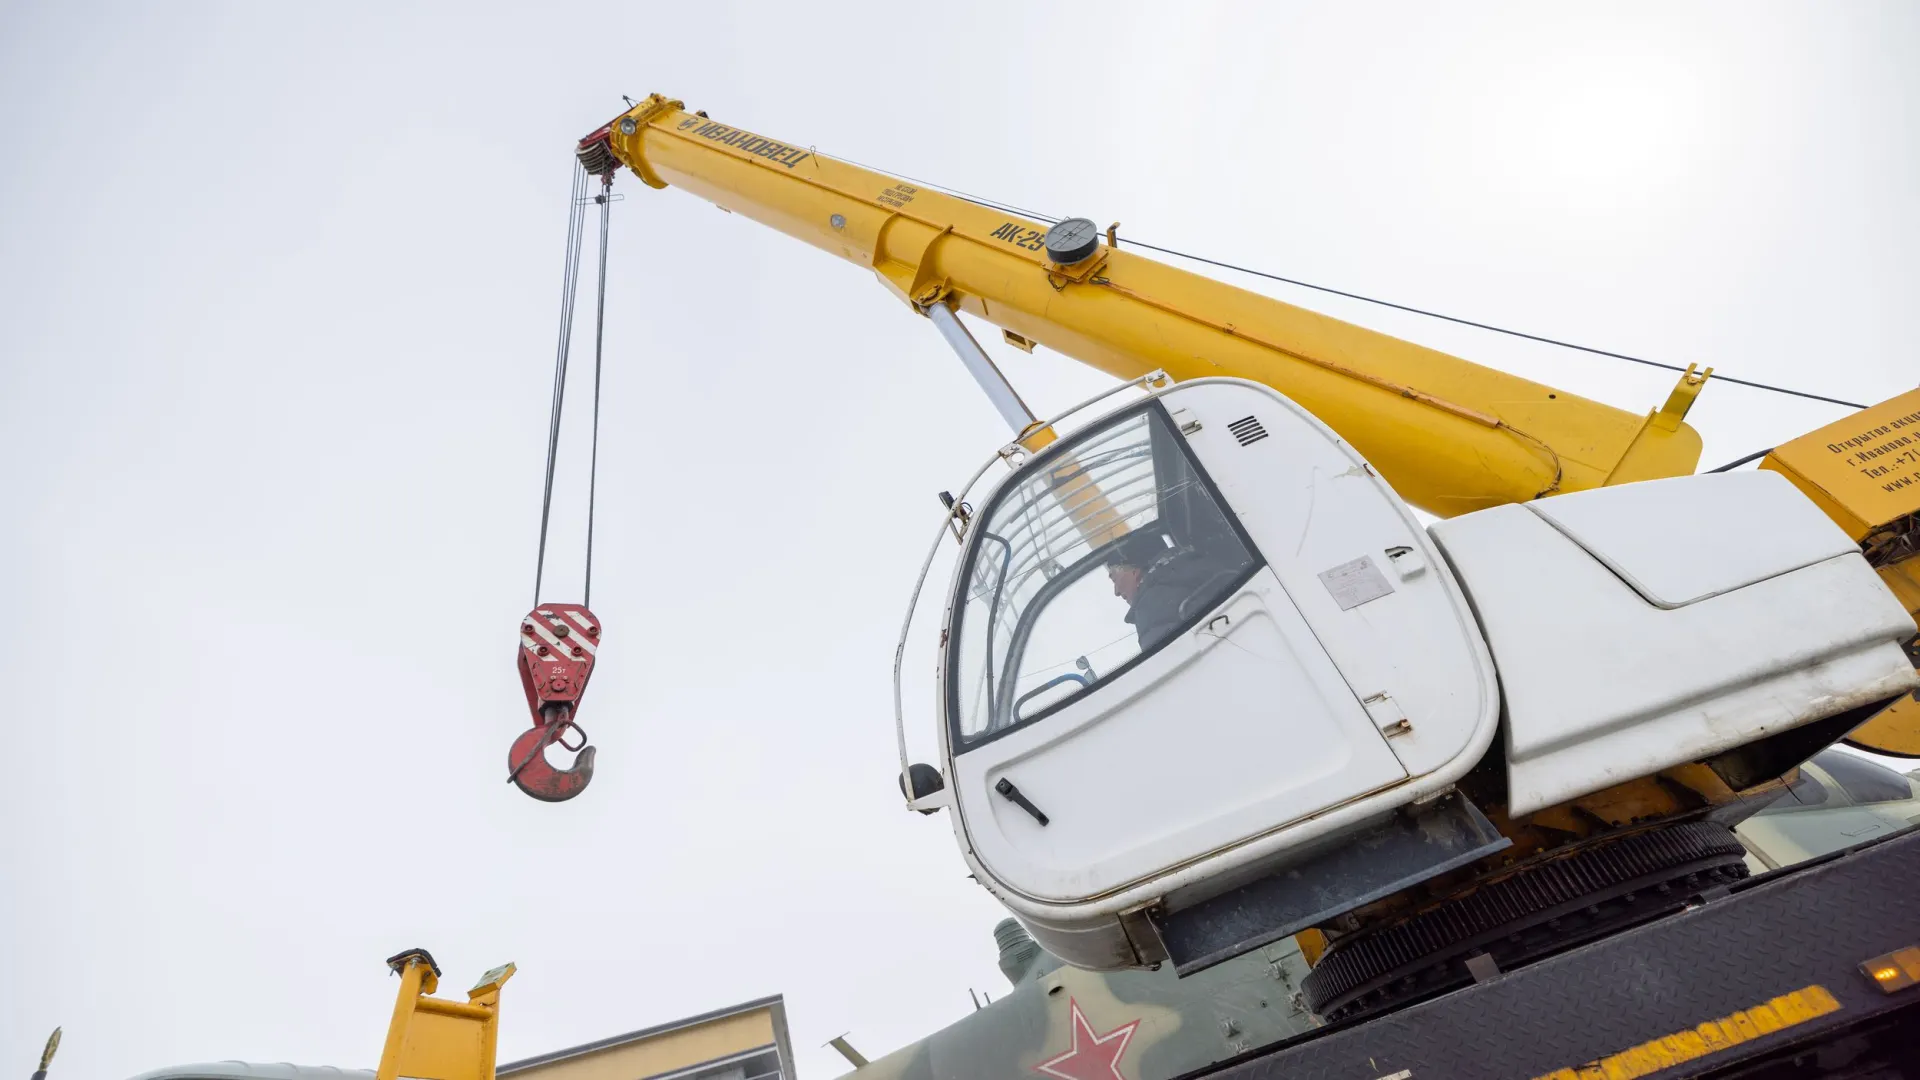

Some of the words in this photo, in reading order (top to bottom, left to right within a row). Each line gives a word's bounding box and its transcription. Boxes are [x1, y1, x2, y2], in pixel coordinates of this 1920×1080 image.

[692, 122, 810, 168] ИВАНОВЕЦ
[1826, 425, 1891, 453] Открытое
[1890, 411, 1920, 429] акци
